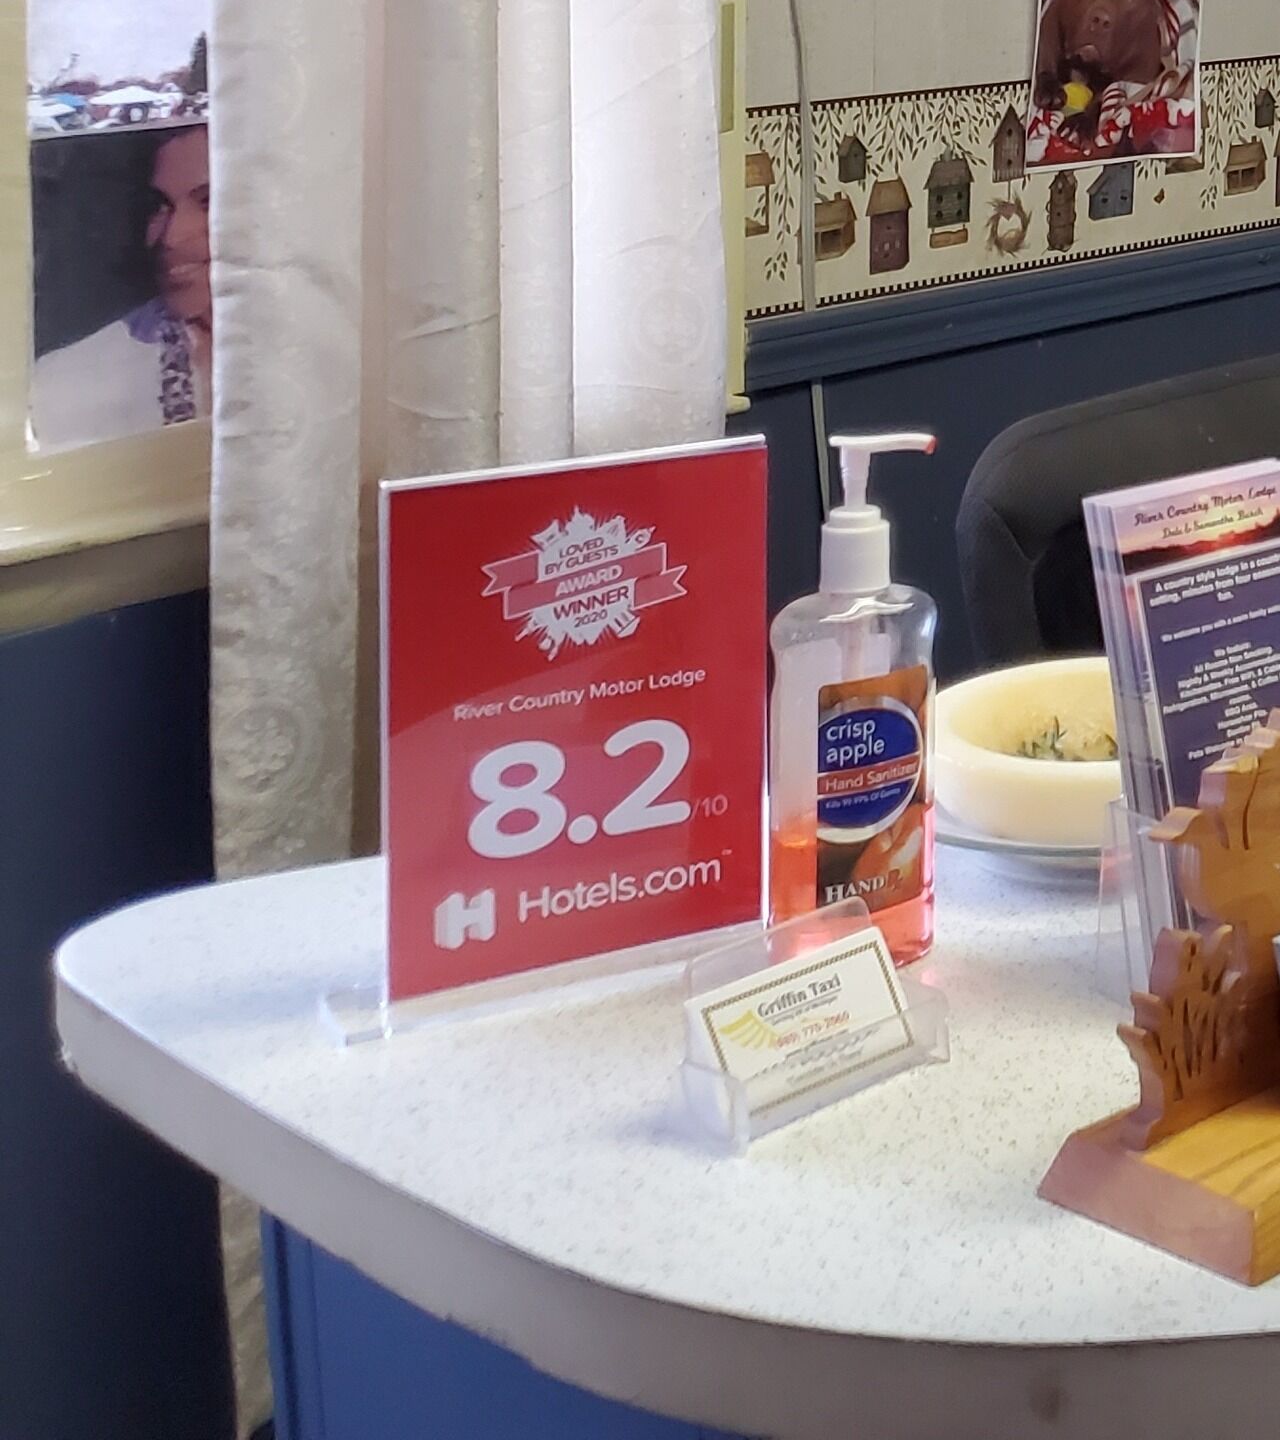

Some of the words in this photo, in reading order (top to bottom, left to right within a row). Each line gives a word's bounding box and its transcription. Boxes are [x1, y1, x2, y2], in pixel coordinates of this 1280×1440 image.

[545, 562, 562, 575] BY
[566, 545, 618, 568] GUESTS
[559, 537, 604, 559] LOVED
[555, 564, 623, 597] AWARD
[553, 585, 629, 620] WINNER
[574, 610, 608, 628] 2020
[453, 700, 504, 722] River
[508, 687, 586, 715] Country
[588, 676, 645, 700] Motor
[648, 667, 707, 692] Lodge
[826, 719, 876, 741] crisp
[826, 736, 885, 768] apple
[467, 718, 691, 860] 8.2
[826, 773, 863, 792] Hand
[866, 761, 918, 785] Sanitizer
[518, 854, 723, 923] Hotels.com
[825, 875, 885, 903] HAND
[757, 990, 807, 1017] Griffin
[808, 973, 841, 996] Taxi
